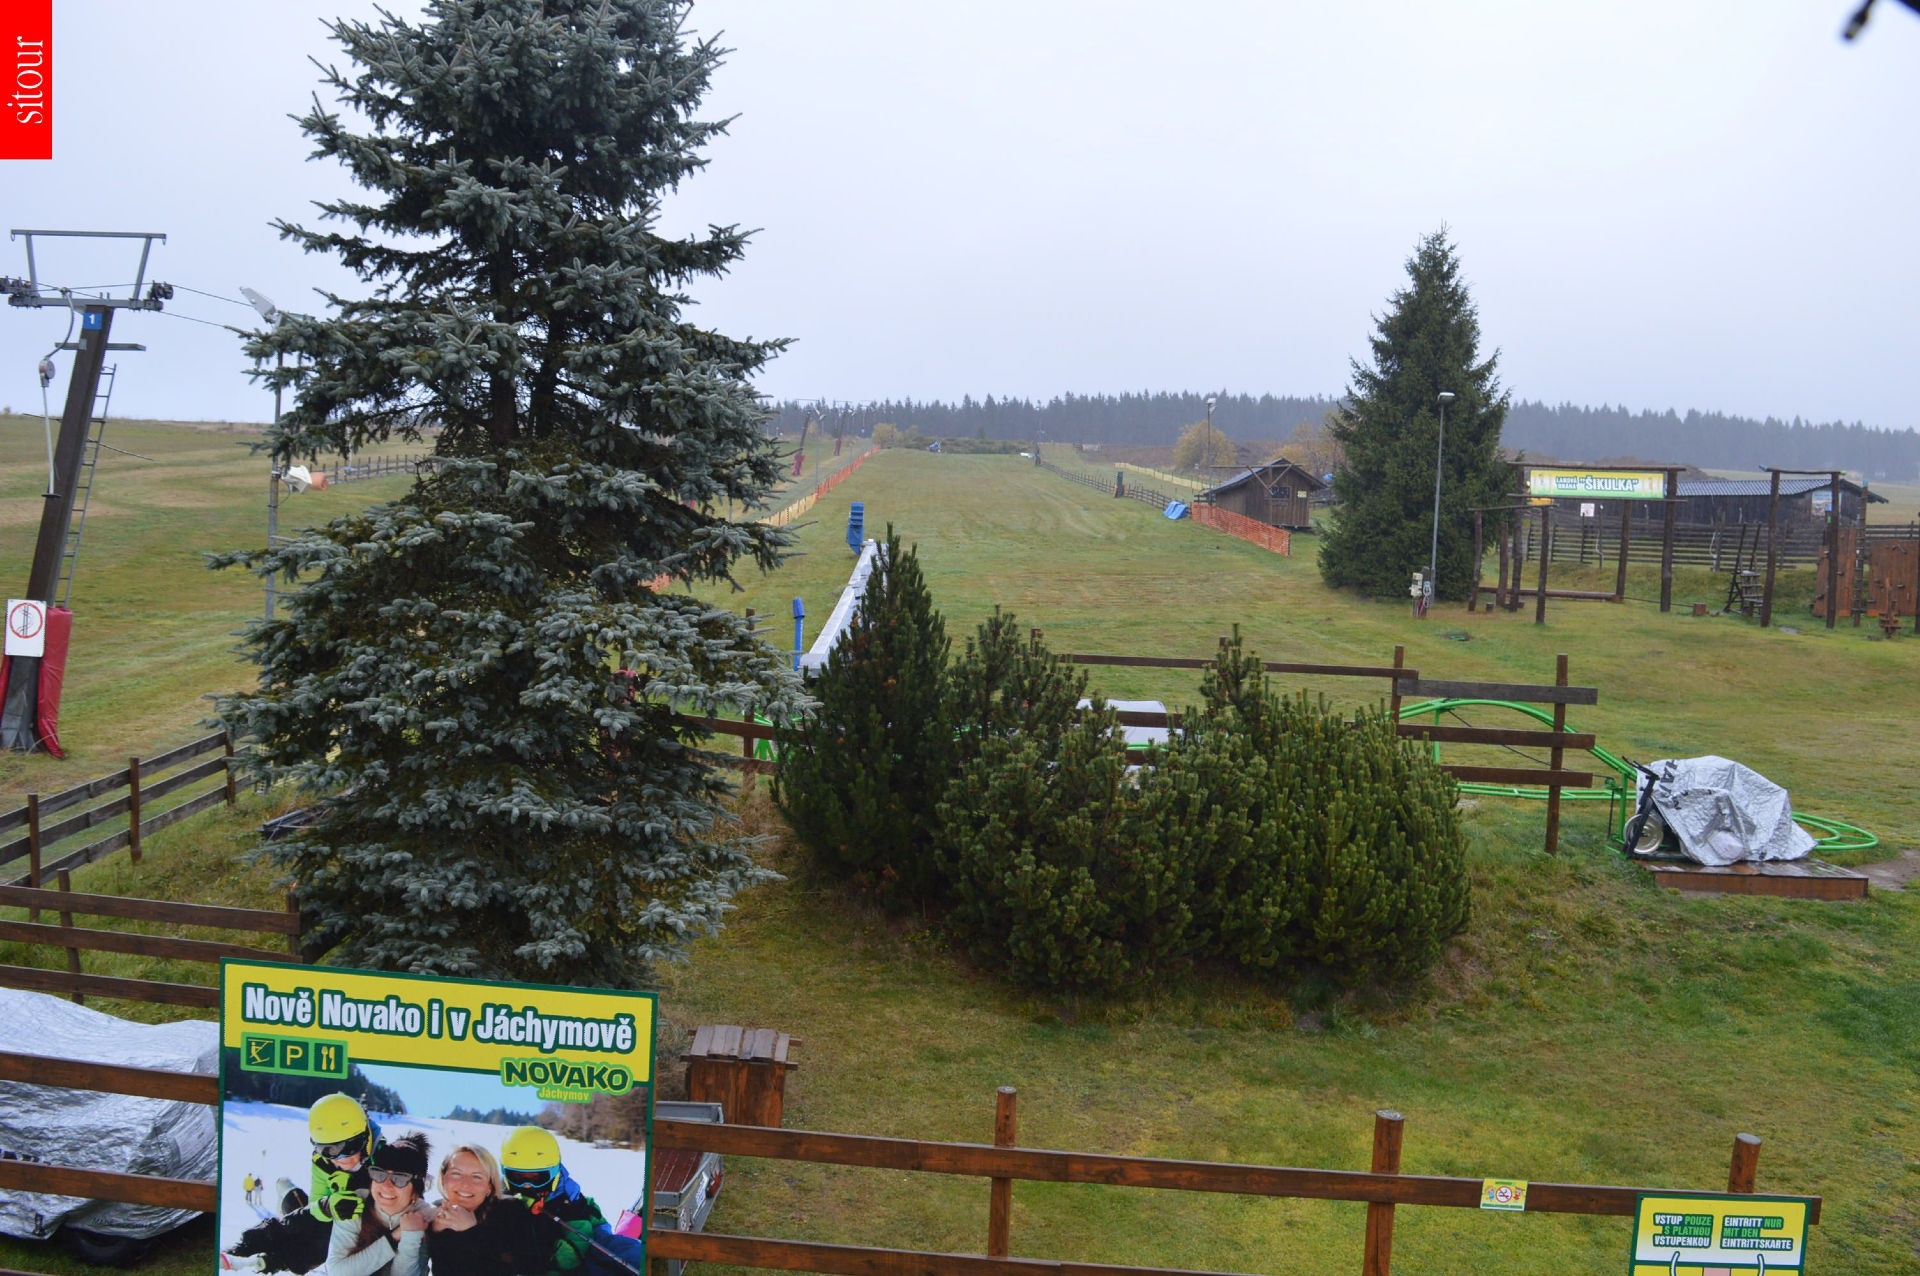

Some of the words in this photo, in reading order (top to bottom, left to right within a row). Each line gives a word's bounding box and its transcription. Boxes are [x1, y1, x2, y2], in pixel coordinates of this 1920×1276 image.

[89, 314, 95, 324] 1
[245, 986, 312, 1024] Nově
[322, 993, 421, 1033] Novako
[431, 1003, 439, 1035] i
[450, 1011, 467, 1037] v
[476, 1007, 632, 1050] Jáchymově
[505, 1061, 629, 1091] NOVAKO
[539, 1088, 589, 1101] Jáchymov
[1655, 1214, 1683, 1225] VSTUP
[1684, 1216, 1712, 1226] POUZE
[1724, 1217, 1762, 1227] EINTRITT
[1764, 1218, 1782, 1228] NUR
[1664, 1225, 1671, 1235] S
[1672, 1226, 1711, 1236] PLATNOU
[1723, 1227, 1740, 1237] MIT
[1741, 1228, 1759, 1237] DEN
[1654, 1235, 1711, 1247] VSTUPENKOU
[1721, 1238, 1792, 1249] EINTRITTSKARTE
